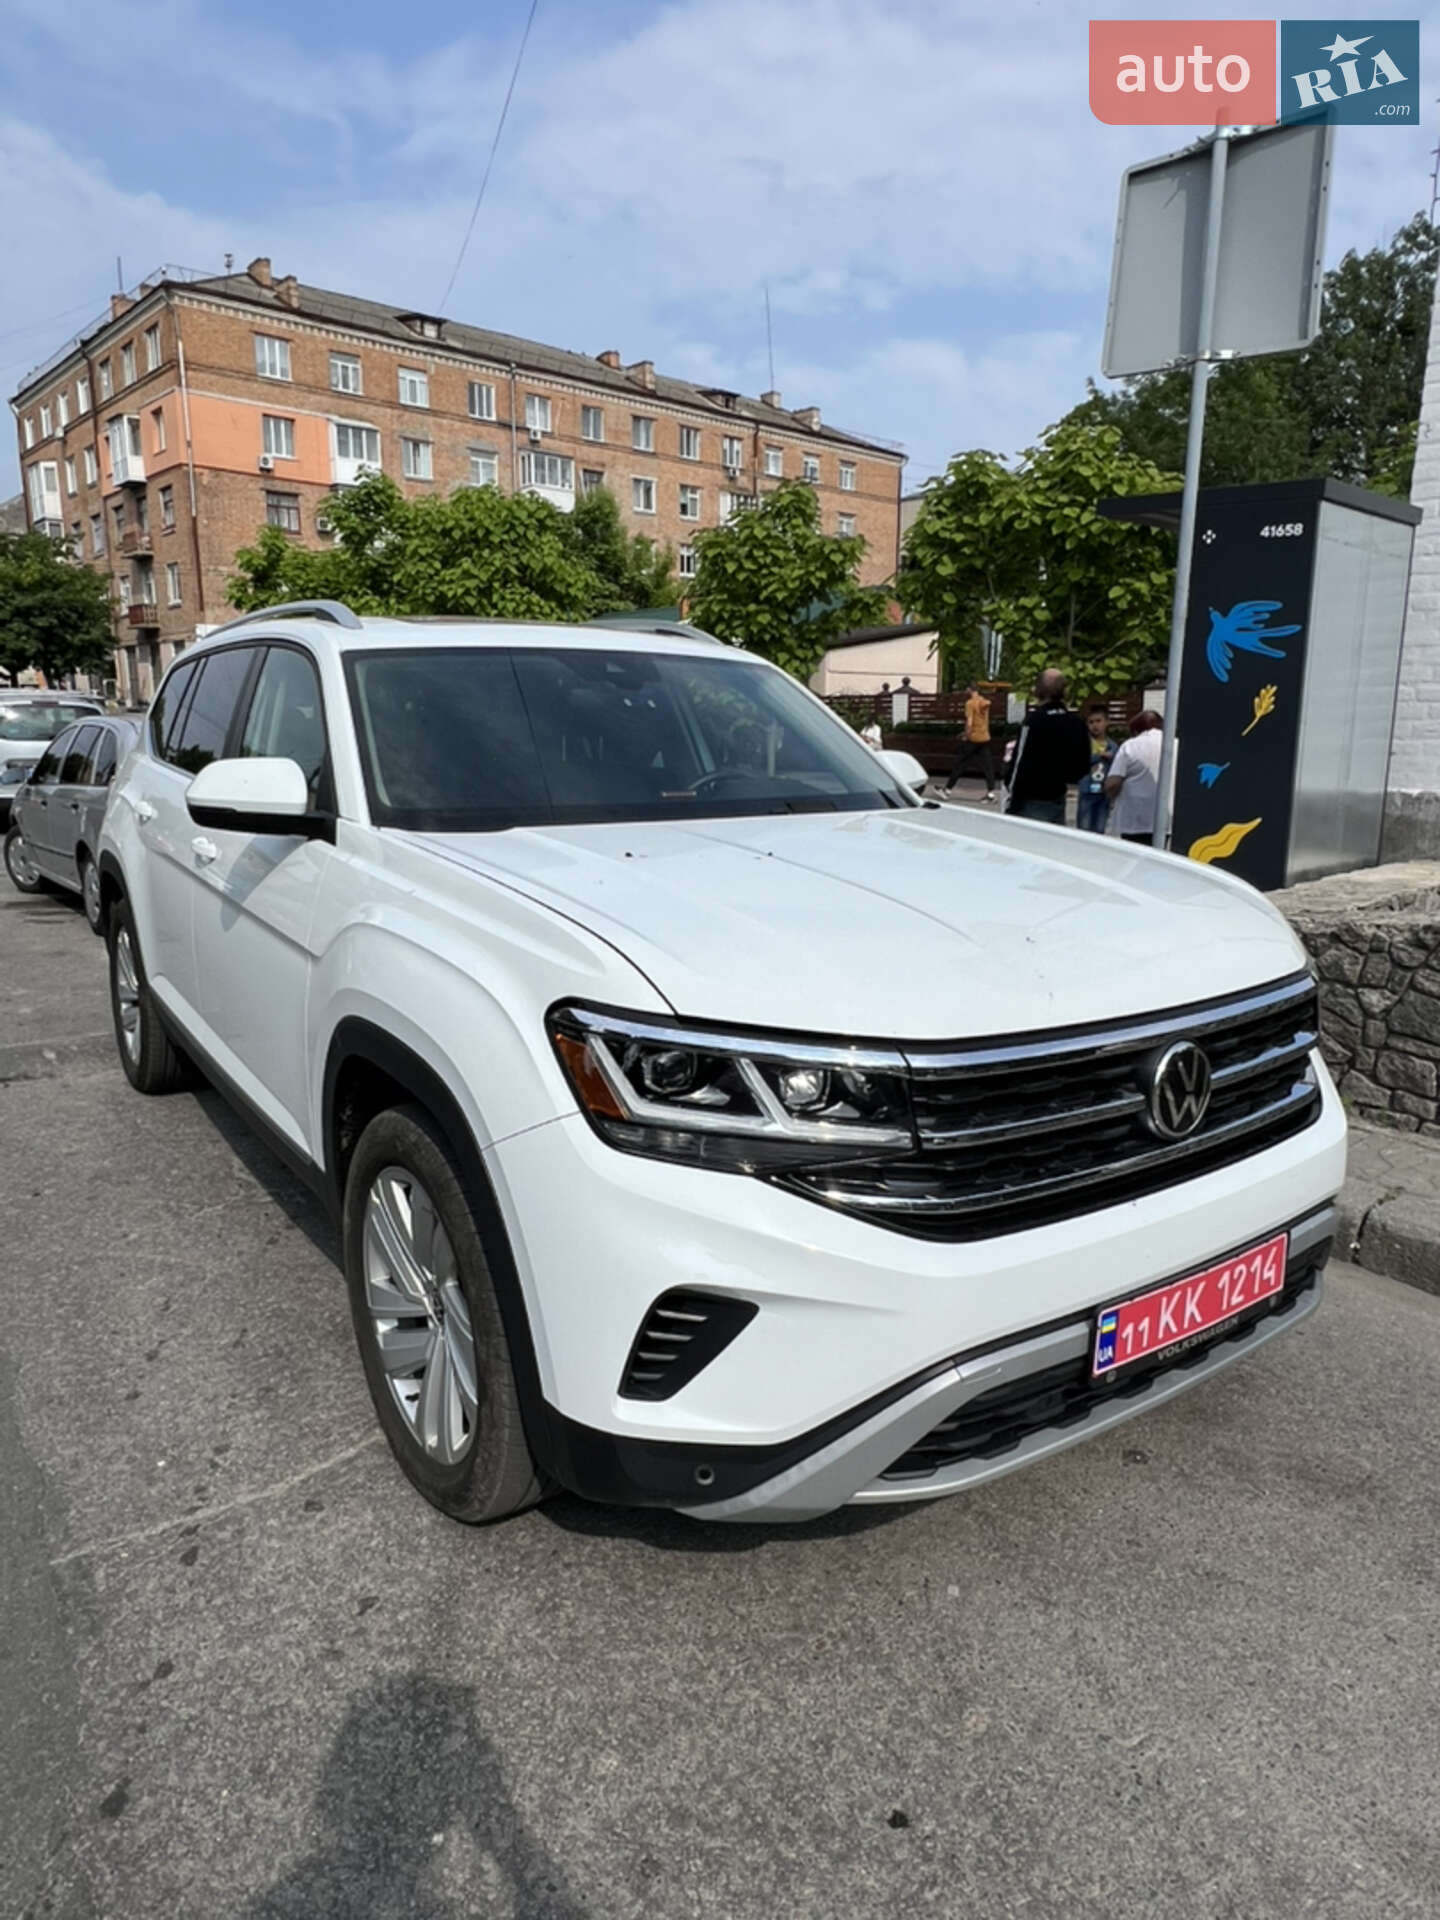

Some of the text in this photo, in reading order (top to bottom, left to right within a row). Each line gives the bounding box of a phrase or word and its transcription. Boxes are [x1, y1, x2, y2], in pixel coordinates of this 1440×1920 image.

[1260, 522, 1304, 538] 41658
[1121, 1246, 1278, 1355] 11 KK 1214
[1098, 1345, 1114, 1363] UA
